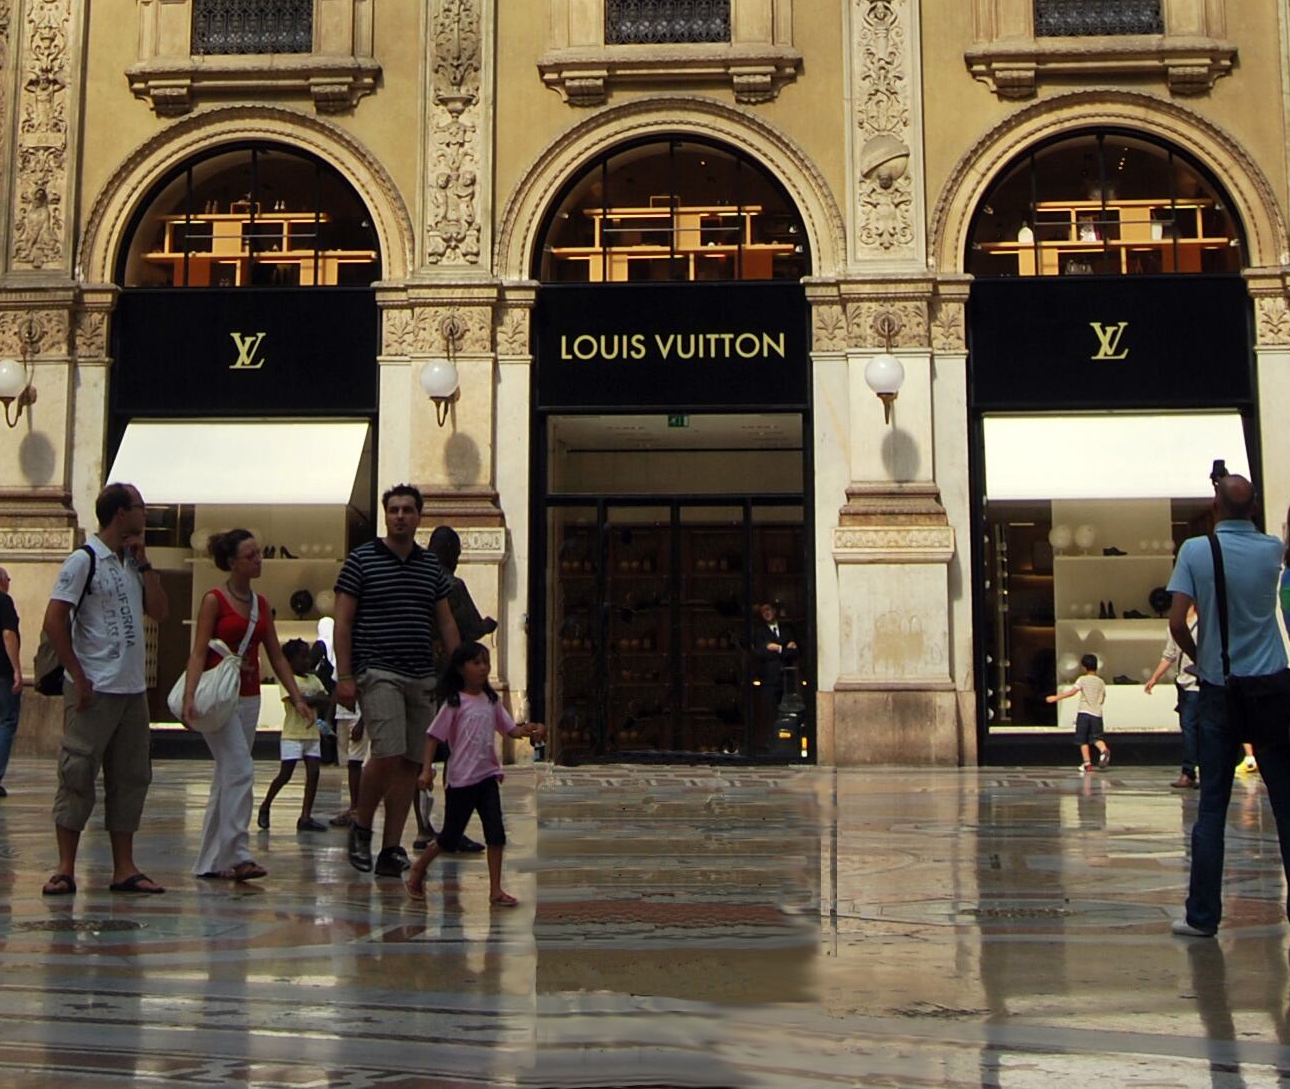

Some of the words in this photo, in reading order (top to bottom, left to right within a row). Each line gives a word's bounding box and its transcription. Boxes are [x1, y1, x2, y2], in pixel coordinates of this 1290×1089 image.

[229, 332, 267, 370] LV
[561, 334, 645, 361] LOUIS
[655, 331, 786, 360] VUITTON
[1090, 322, 1129, 360] LV
[108, 567, 136, 648] CALIFORNIA
